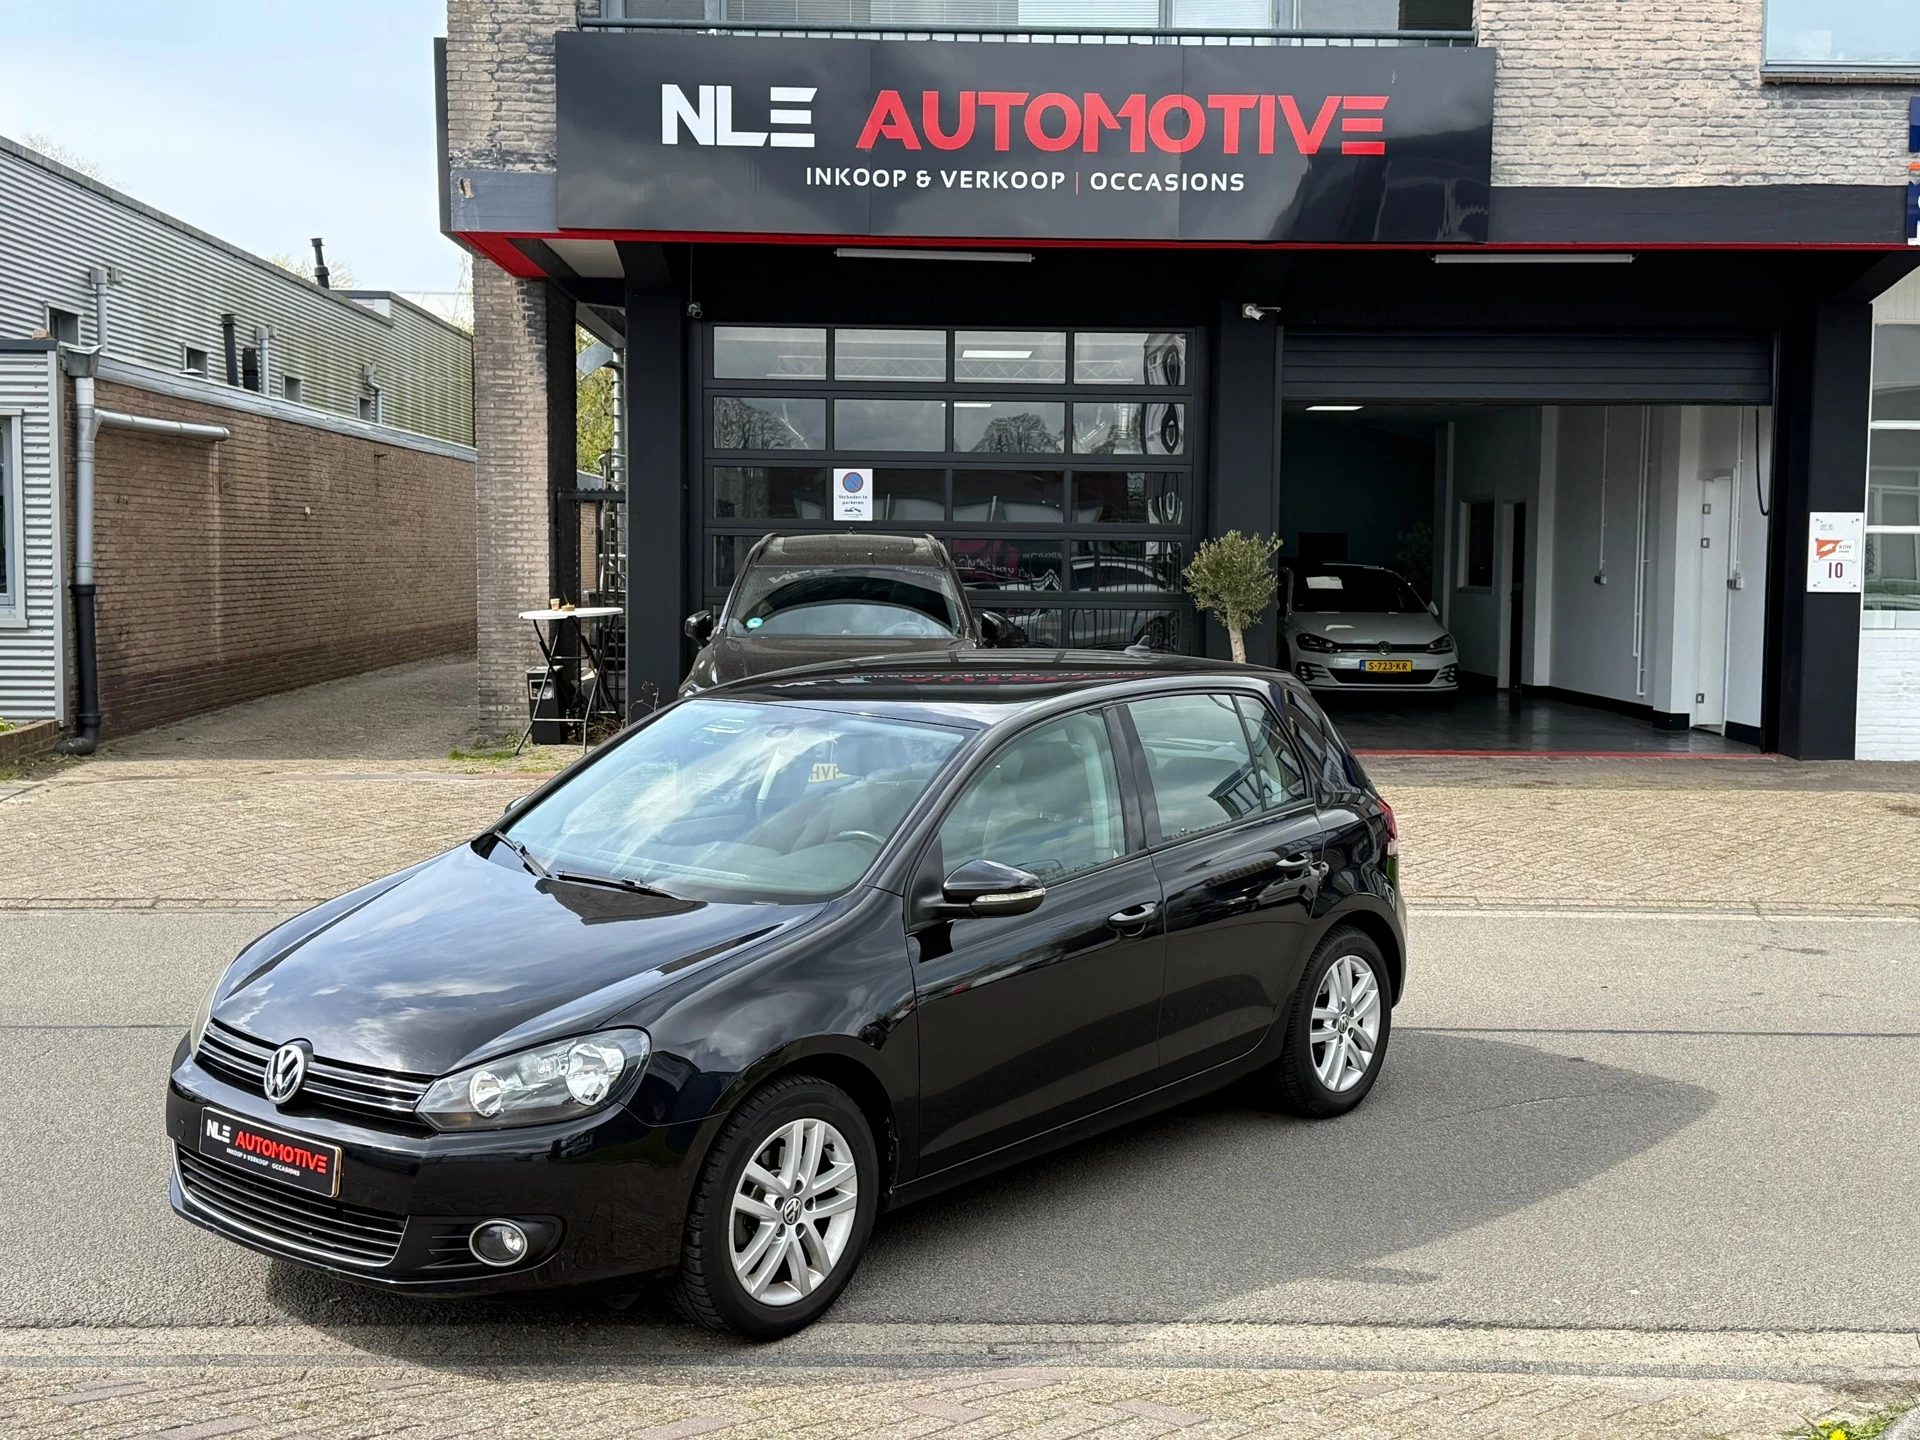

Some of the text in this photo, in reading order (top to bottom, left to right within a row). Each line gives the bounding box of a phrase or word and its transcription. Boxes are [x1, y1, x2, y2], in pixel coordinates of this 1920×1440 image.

[661, 83, 1390, 155] NLE AUTOMOTIVE
[806, 167, 1245, 192] INKOOP & VERKOOP OCCASIONS
[1828, 562, 1843, 578] 10
[1368, 661, 1408, 671] S-723-KR
[206, 1119, 328, 1174] NLE AUTOMOTIVE
[226, 1147, 243, 1158] INKOOP
[247, 1154, 269, 1167] VERKOOP
[271, 1163, 301, 1177] OCCASIONS
